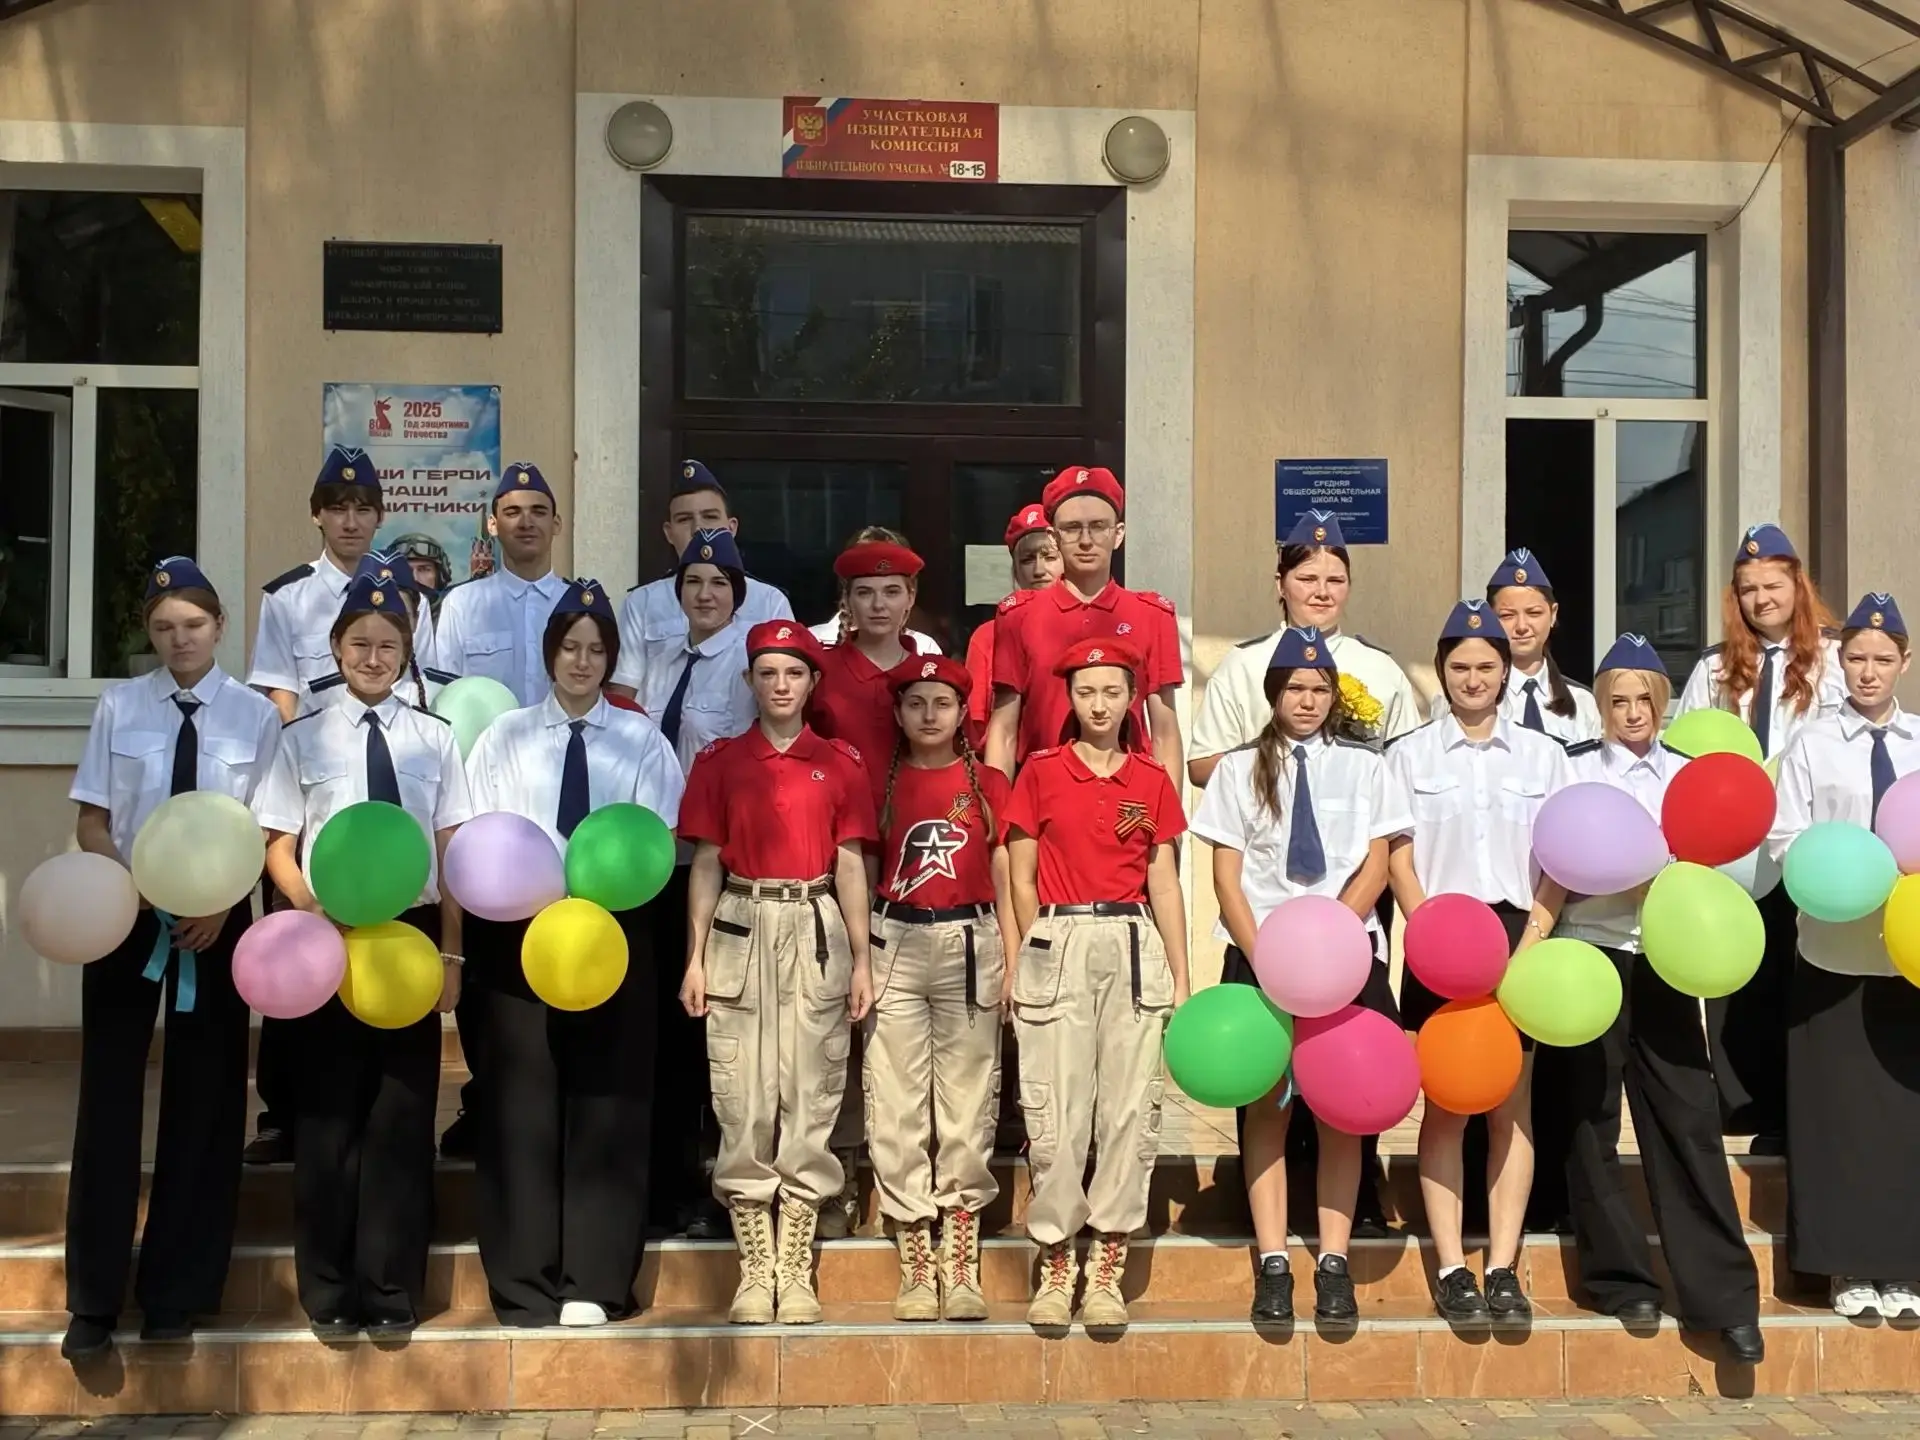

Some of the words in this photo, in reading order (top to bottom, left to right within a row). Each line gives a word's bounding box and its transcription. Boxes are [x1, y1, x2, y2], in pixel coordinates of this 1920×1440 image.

[862, 109, 969, 123] УЧАСТКОВАЯ
[846, 123, 984, 139] ИЗБИРАТЕЛЬНАЯ
[870, 139, 959, 153] КОМИССИЯ
[796, 159, 885, 174] ИЗБИРАТЕЛЬНОГО
[889, 162, 934, 175] УЧАСТКА
[951, 163, 985, 177] 18-15
[403, 401, 442, 418] 2025
[403, 420, 420, 430] Год
[421, 421, 470, 430] защитника
[403, 430, 448, 438] Отечества
[376, 469, 404, 480] ШИ
[412, 469, 491, 481] ГЕРОИ
[1314, 479, 1350, 487] СРЕДНЯЯ
[382, 485, 448, 497] НАШИ
[1282, 488, 1381, 496] ОБЩЕОБРАЗОВАТЕЛЬНАЯ
